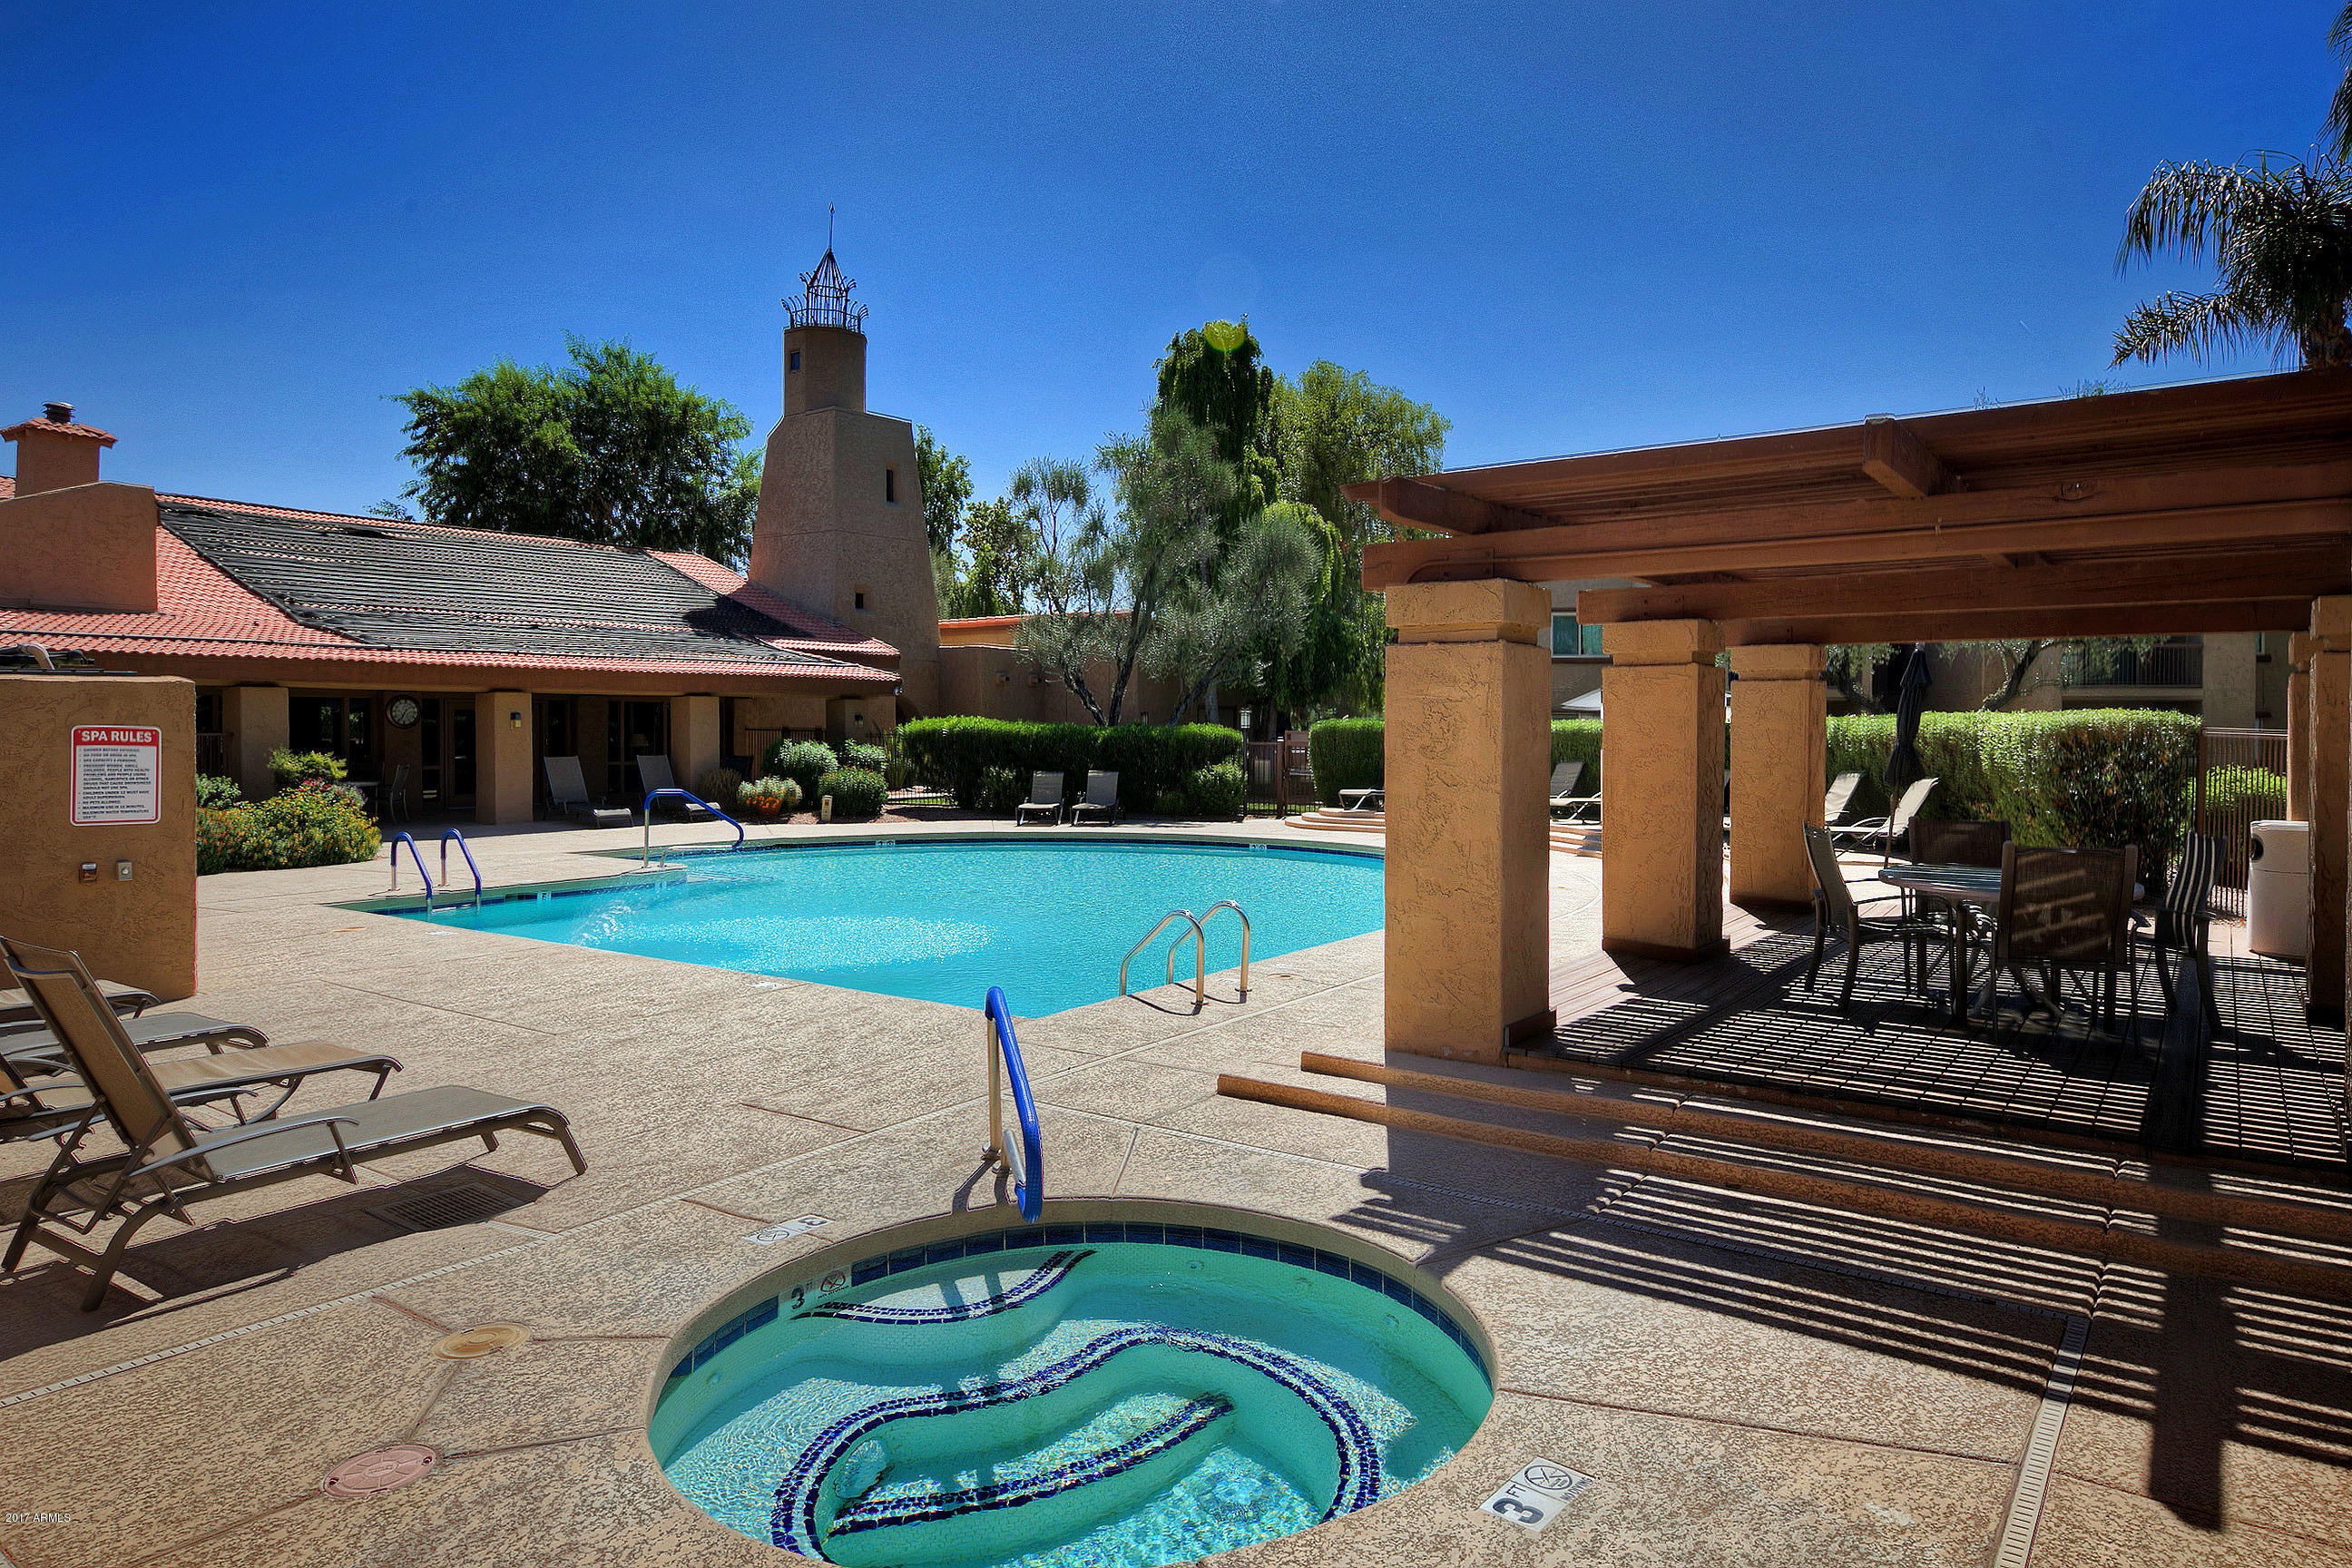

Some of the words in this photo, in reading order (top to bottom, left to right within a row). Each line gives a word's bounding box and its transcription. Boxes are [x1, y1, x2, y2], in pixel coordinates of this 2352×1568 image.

[81, 730, 108, 741] SPA
[111, 731, 152, 743] RULES
[1505, 1485, 1526, 1498] FT
[1492, 1498, 1544, 1524] 3
